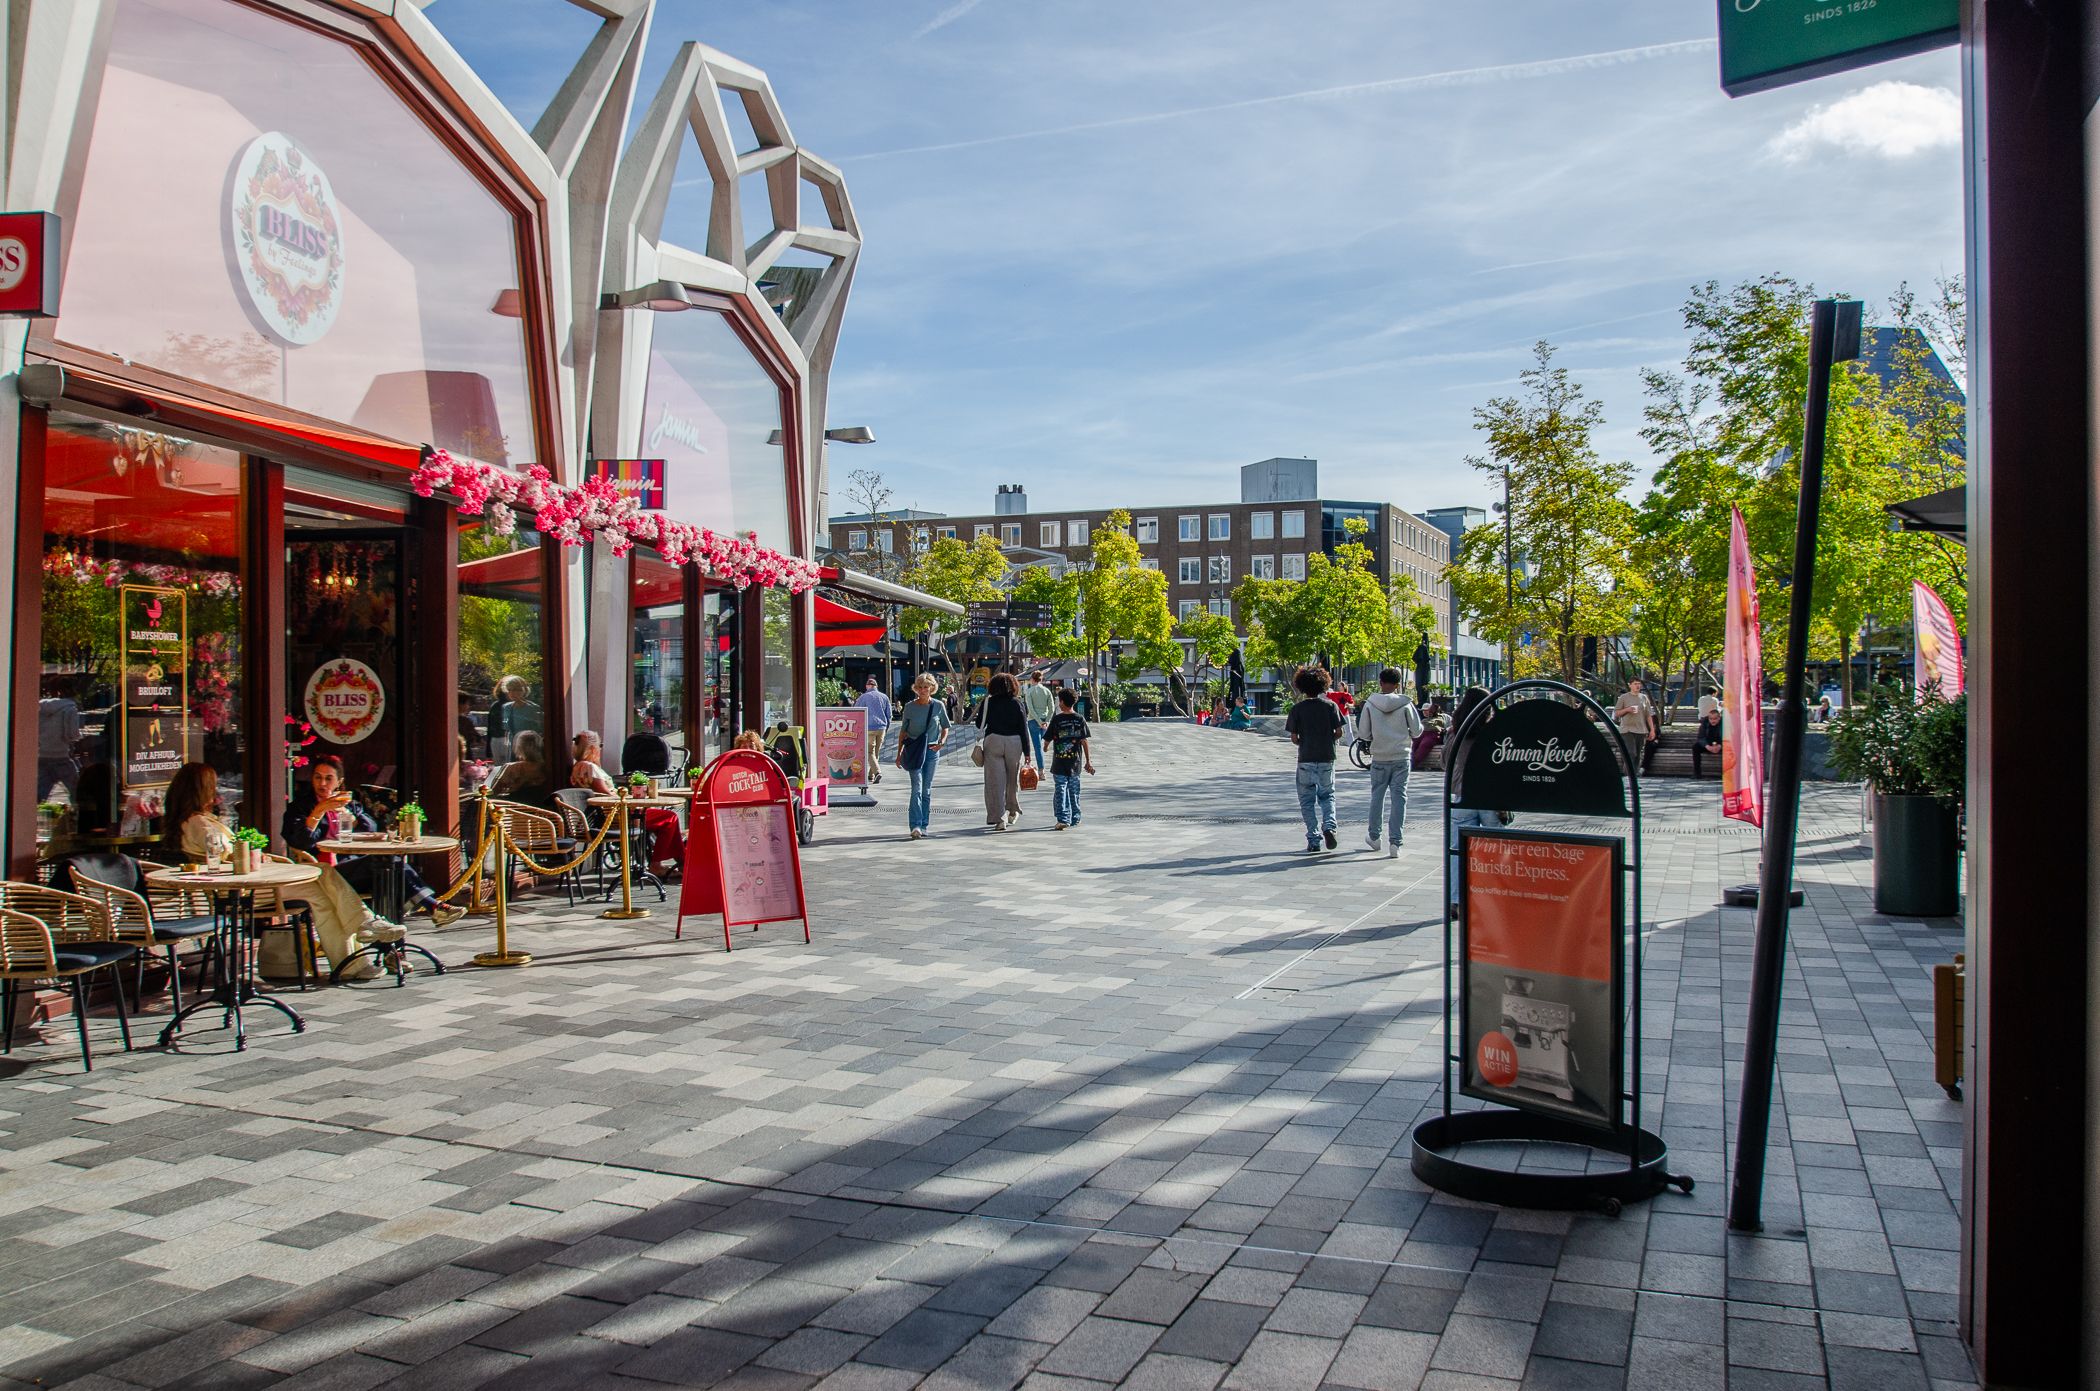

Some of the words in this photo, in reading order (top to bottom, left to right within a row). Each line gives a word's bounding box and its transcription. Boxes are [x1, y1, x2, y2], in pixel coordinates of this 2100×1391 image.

[1804, 4, 1843, 24] SINDS
[1848, 0, 1877, 14] 1826
[260, 204, 329, 260] BLISS
[0, 246, 20, 272] S
[267, 242, 278, 258] by
[649, 401, 708, 453] jamin
[131, 630, 179, 642] BABYSHOWER
[138, 686, 173, 696] BRUILOFT
[323, 693, 368, 707] BLISS
[825, 719, 856, 733] DOT
[1491, 736, 1543, 764] Simon
[728, 771, 769, 794] COCKTAIL
[1469, 836, 1499, 853] Win
[1499, 839, 1526, 856] hier
[1526, 846, 1550, 858] een
[1553, 843, 1585, 864] Sage
[1469, 857, 1512, 876] Barista
[1515, 861, 1570, 882] Express.
[1484, 1045, 1511, 1064] WIN
[1484, 1060, 1511, 1074] ACTIE
